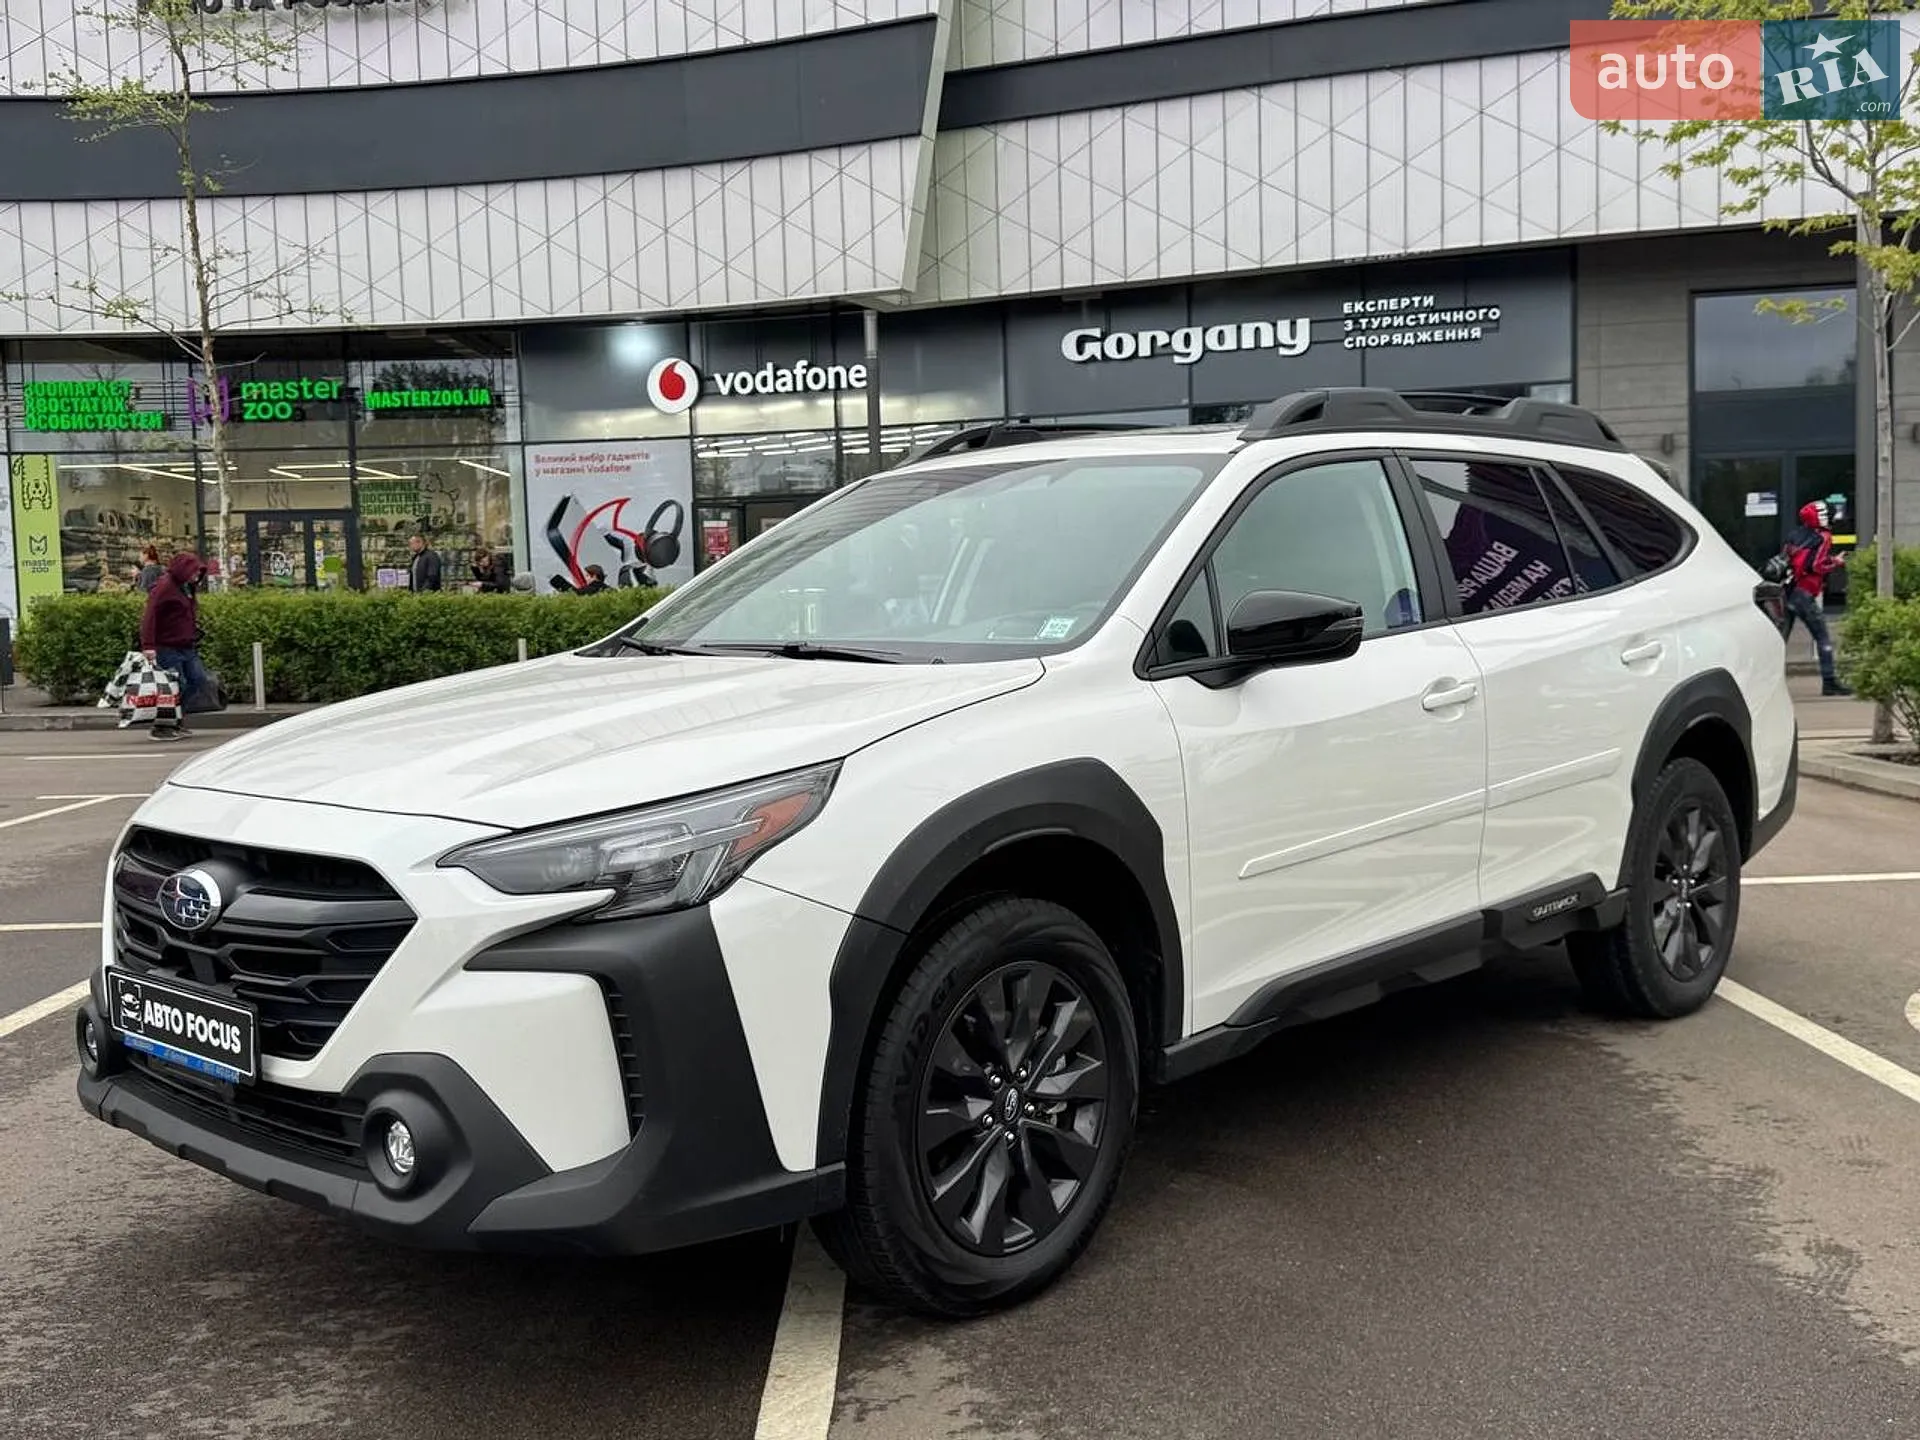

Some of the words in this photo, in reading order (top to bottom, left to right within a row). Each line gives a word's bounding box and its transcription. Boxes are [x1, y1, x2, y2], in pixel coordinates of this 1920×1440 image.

[1342, 295, 1435, 314] ЕКСПЕРТИ
[1359, 307, 1501, 330] ТУРИСТИЧНОГО
[1061, 318, 1311, 364] Gorgany
[1343, 326, 1482, 349] СПОРЯДЖЕННЯ
[241, 376, 343, 400] master
[714, 360, 868, 396] vodafone
[365, 387, 492, 410] MASTERZOO.UA
[242, 401, 293, 421] zoo
[143, 1000, 184, 1035] АВТО
[186, 1012, 242, 1054] FOCUS
